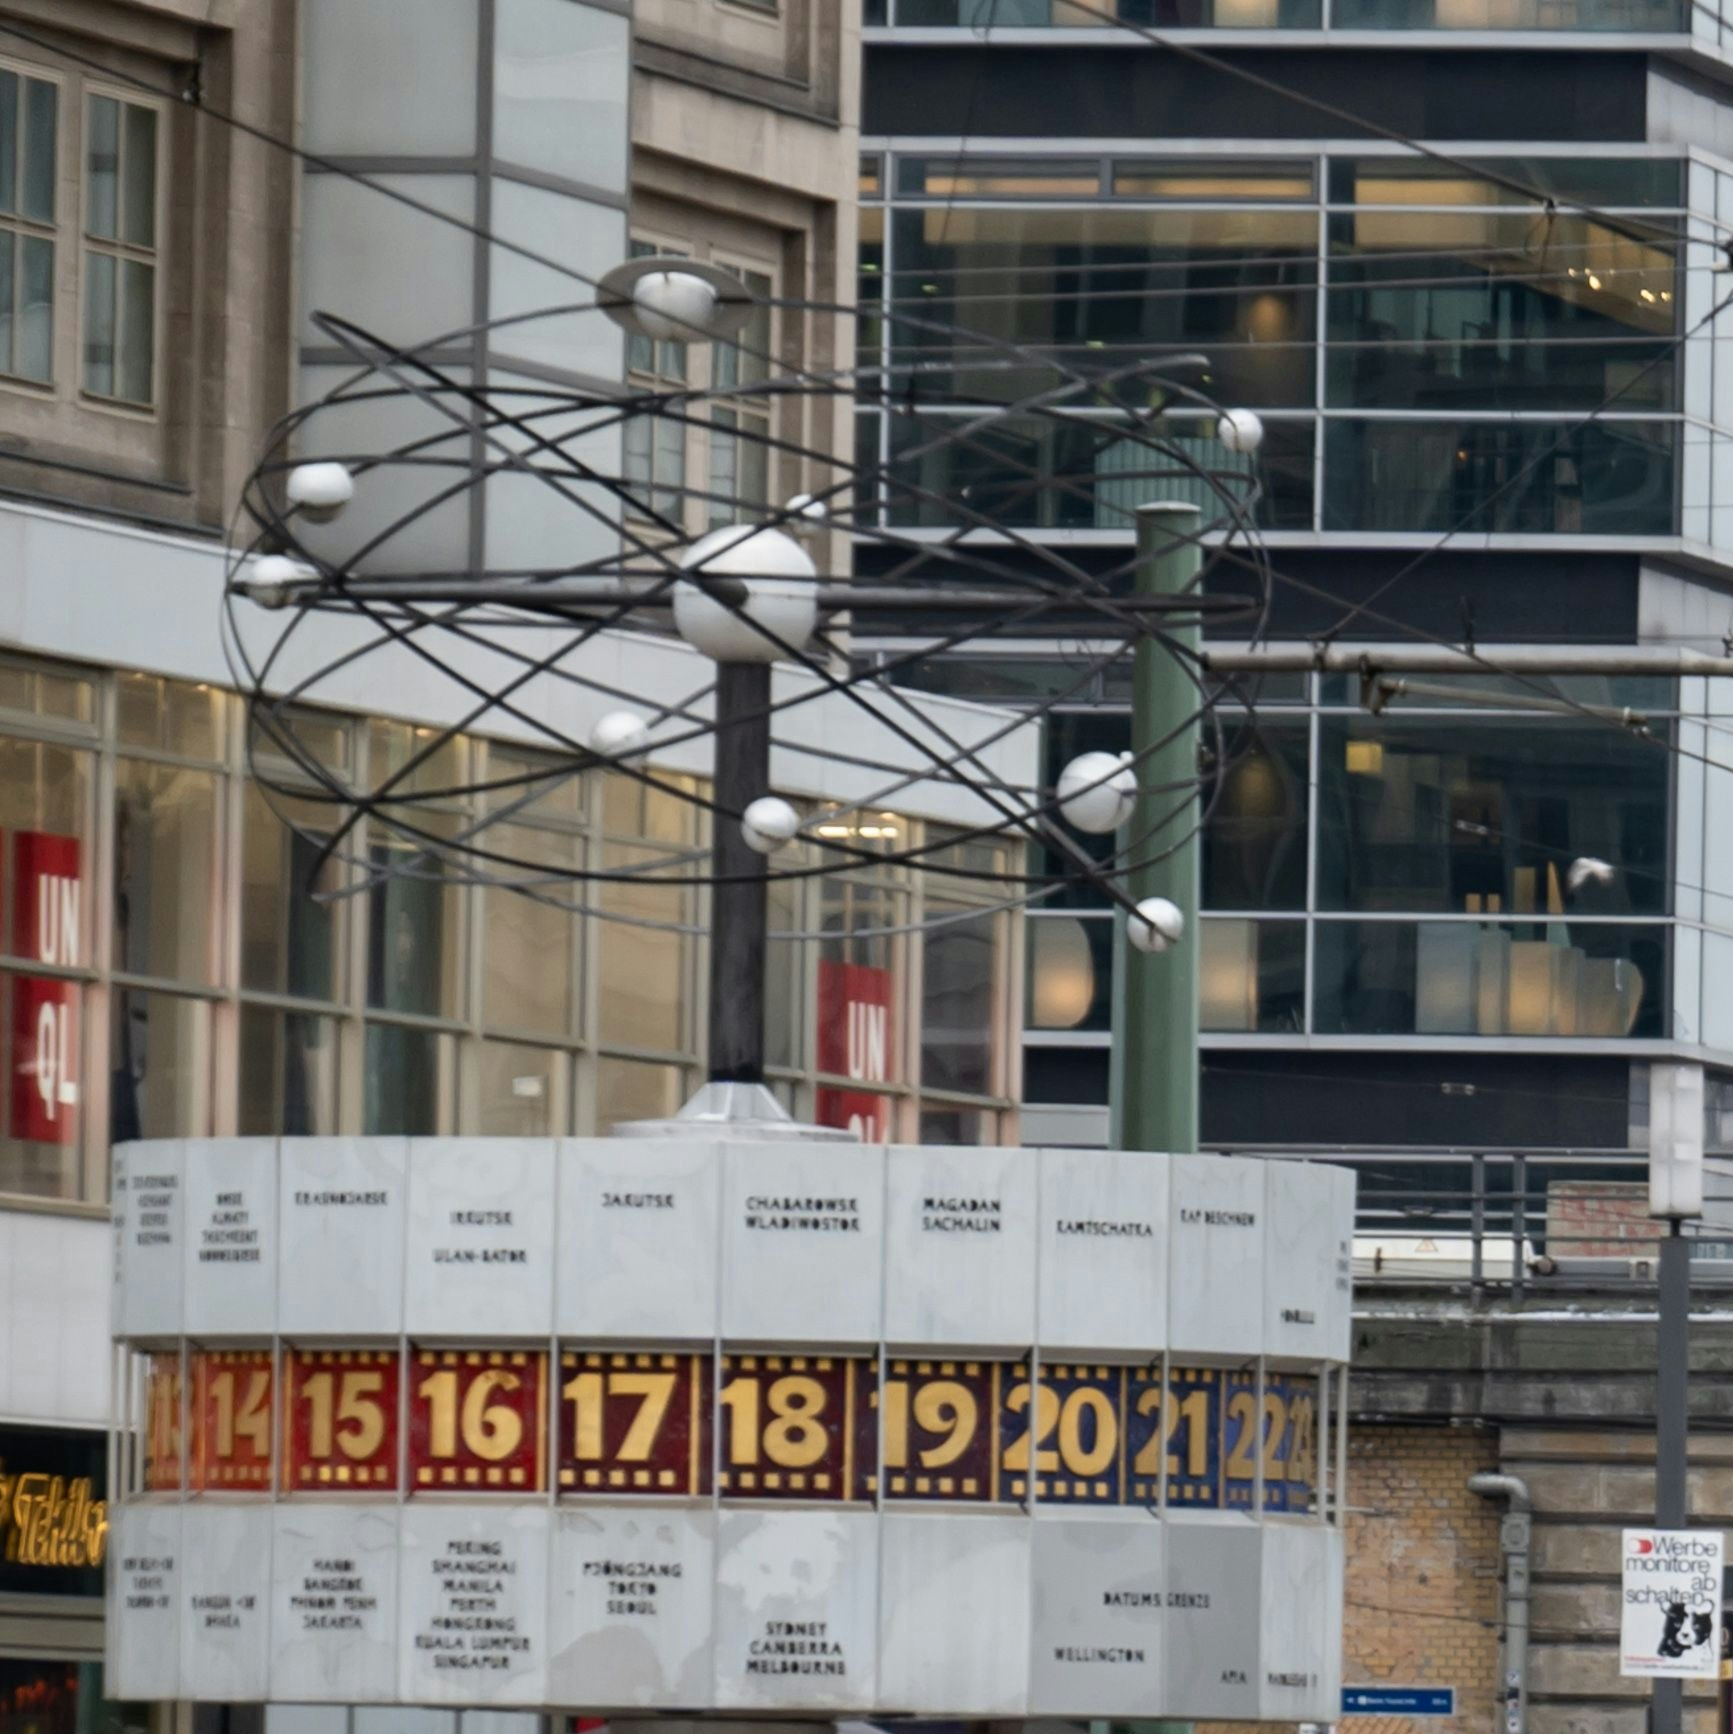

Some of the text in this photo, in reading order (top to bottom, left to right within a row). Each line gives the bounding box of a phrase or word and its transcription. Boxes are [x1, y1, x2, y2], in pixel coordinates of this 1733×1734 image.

[602, 1194, 675, 1208] JAKUTSK
[746, 1196, 858, 1212] CHABAROWSK
[923, 1198, 1000, 1212] MAGADAN
[745, 1216, 860, 1231] WLADIWOSTOK
[923, 1216, 1000, 1231] SACHALIN
[1057, 1219, 1153, 1236] KAMTSCHATKA
[209, 1371, 270, 1457] 14
[303, 1371, 385, 1460] 15
[419, 1370, 523, 1461] 16
[564, 1372, 677, 1463] 17
[720, 1376, 829, 1468] 18
[869, 1381, 978, 1469] 19
[1003, 1383, 1119, 1477] 20
[1134, 1388, 1209, 1478] 21
[1226, 1391, 1286, 1479] 22
[1654, 1536, 1719, 1556] Werbe
[432, 1560, 516, 1574] SHANGHAI
[1626, 1556, 1711, 1573] monitore
[443, 1580, 503, 1593] MANILA
[1692, 1573, 1717, 1592] ab
[1103, 1592, 1163, 1606] DATUMS
[607, 1601, 656, 1614] SEOUL
[766, 1622, 827, 1636] SYDNEY
[749, 1642, 842, 1656] CANBERRA
[1055, 1648, 1144, 1663] WELLINGTON
[434, 1655, 509, 1669] SINGAPUR
[746, 1661, 846, 1676] MELBOURNE
